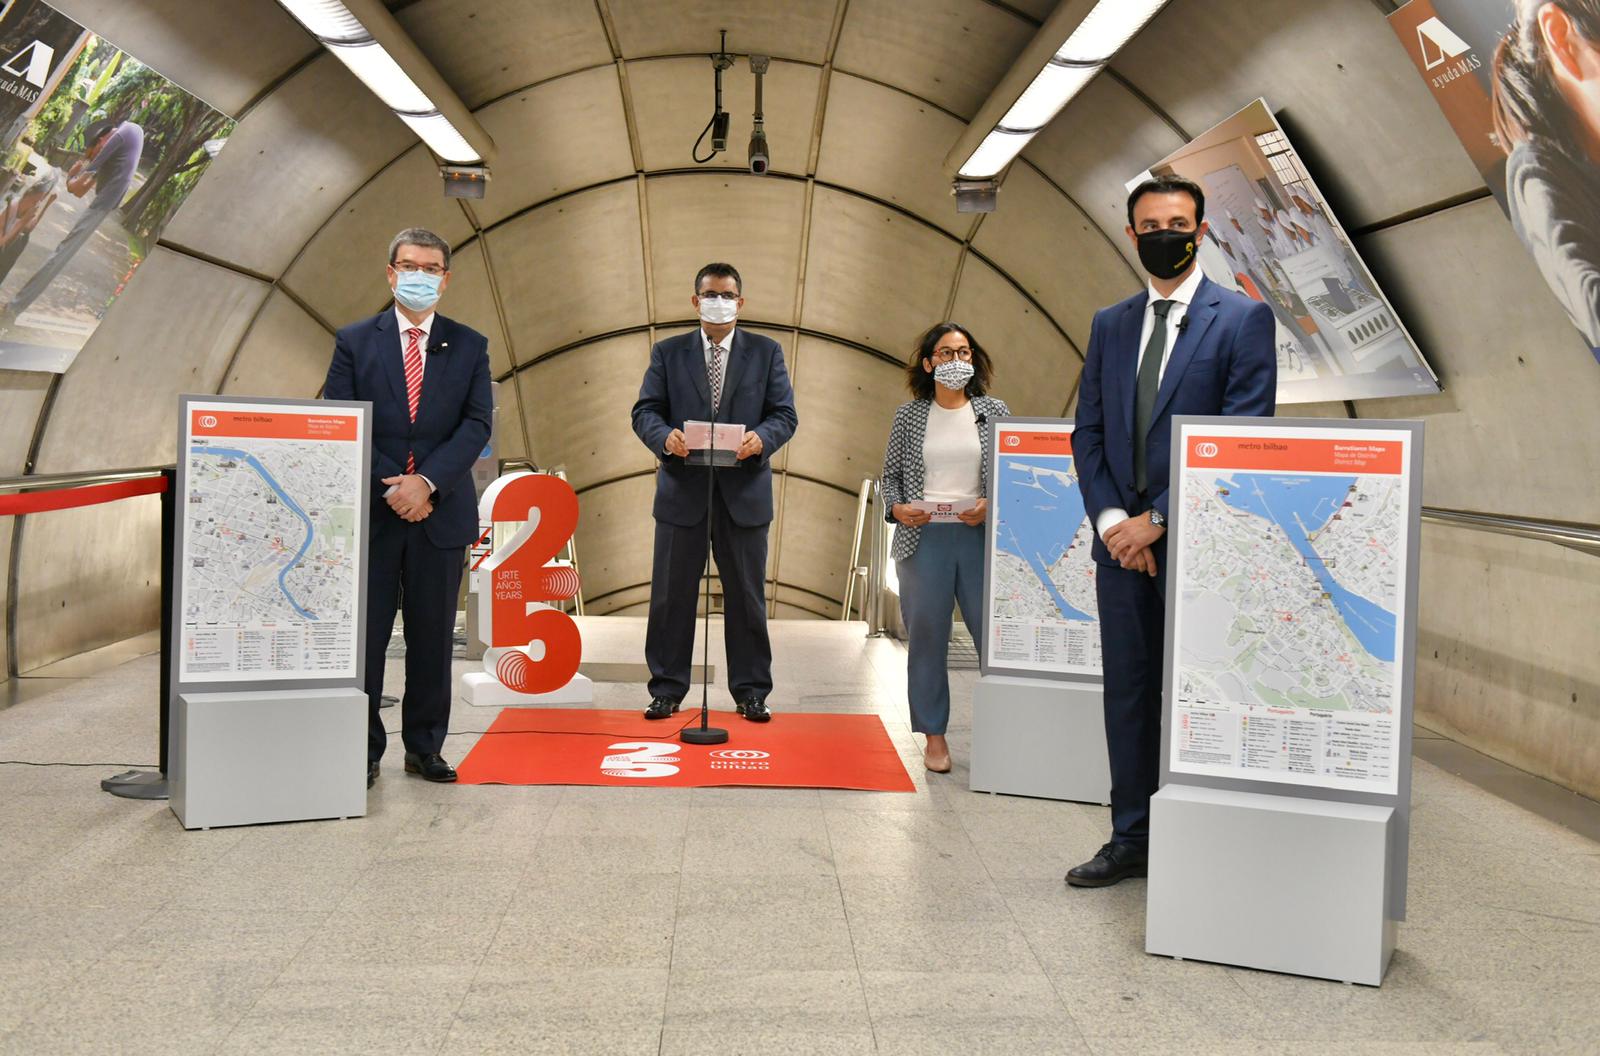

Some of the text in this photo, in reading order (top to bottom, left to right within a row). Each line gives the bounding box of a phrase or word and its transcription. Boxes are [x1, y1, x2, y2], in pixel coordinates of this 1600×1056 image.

[1432, 54, 1481, 88] ayudaMAS
[0, 79, 39, 103] udaMAS
[1263, 443, 1288, 451] bilbao
[497, 569, 520, 580] URTE
[496, 579, 522, 590] AÑOS
[495, 590, 522, 600] YEARS
